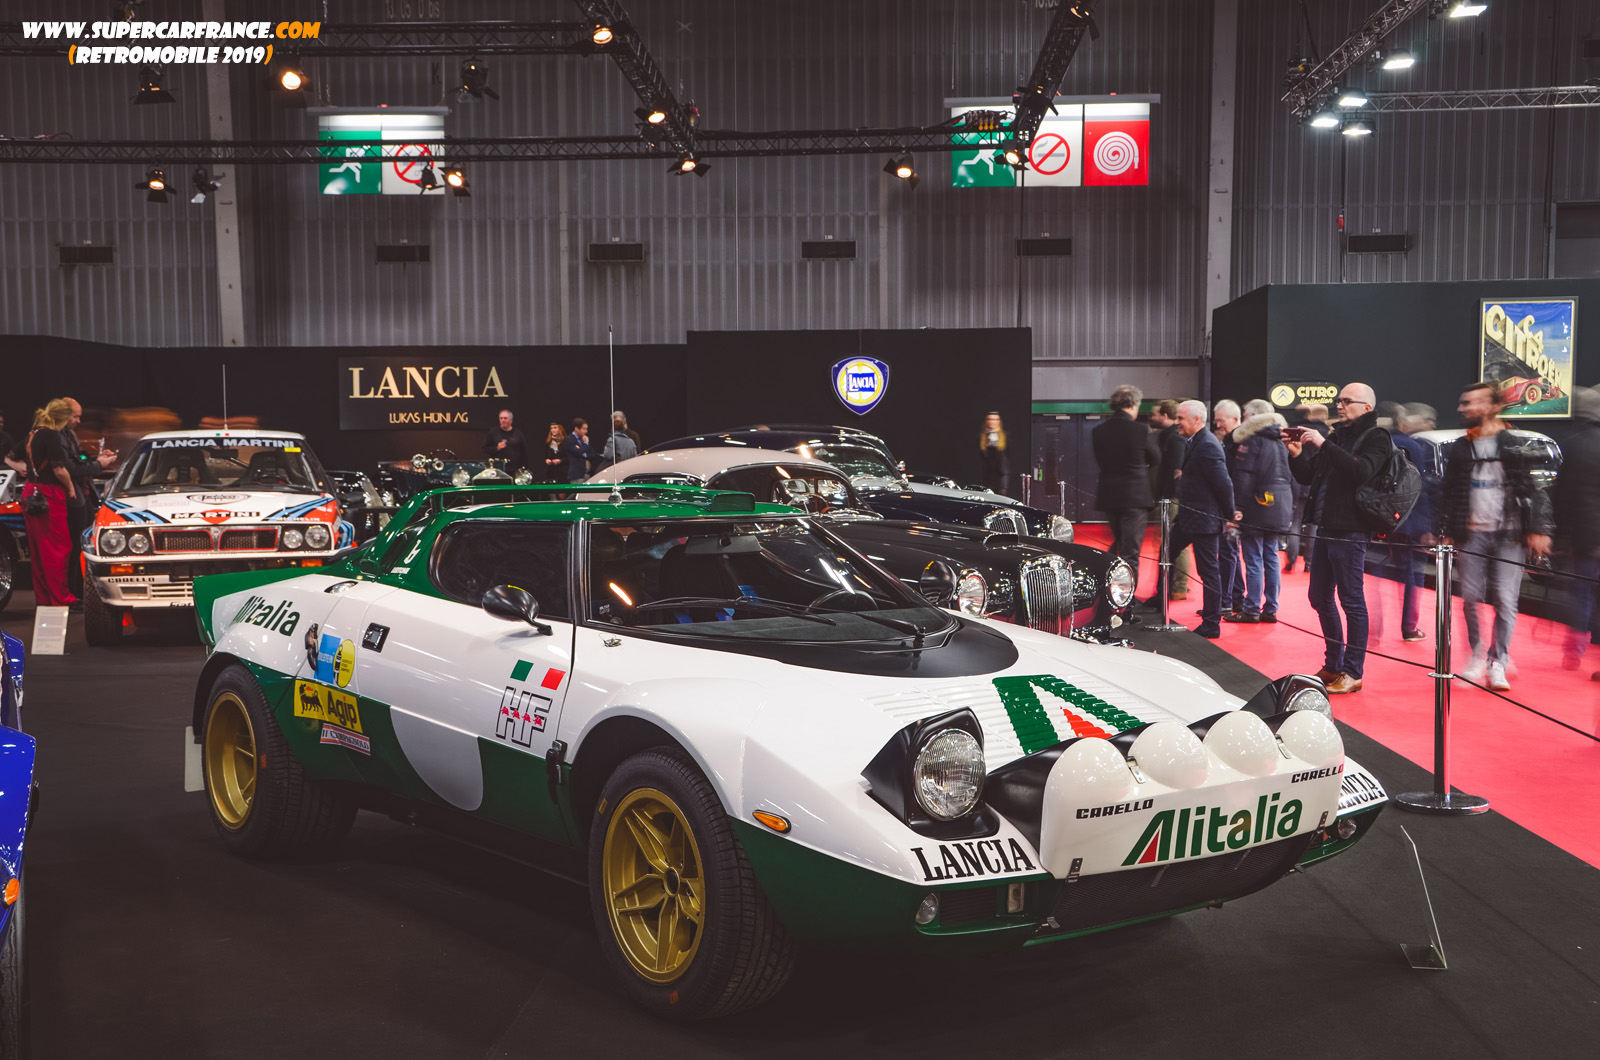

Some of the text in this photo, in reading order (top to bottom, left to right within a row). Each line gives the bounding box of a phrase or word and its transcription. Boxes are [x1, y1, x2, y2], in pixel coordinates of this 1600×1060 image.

[348, 366, 508, 398] LANCIA
[848, 374, 875, 392] LANCIA
[1296, 386, 1338, 398] CITRO
[389, 412, 420, 424] LUKAS
[453, 412, 469, 424] AG
[151, 439, 295, 449] LANCIA MARTINI
[174, 511, 257, 519] MARTINI
[229, 595, 301, 637] Alitalia
[327, 690, 358, 729] Agip
[496, 686, 553, 748] HF
[1291, 764, 1344, 783] CARELLO
[1076, 799, 1154, 819] CARELLO
[1121, 792, 1303, 867] Alitalia
[910, 838, 1037, 882] LANCIA
